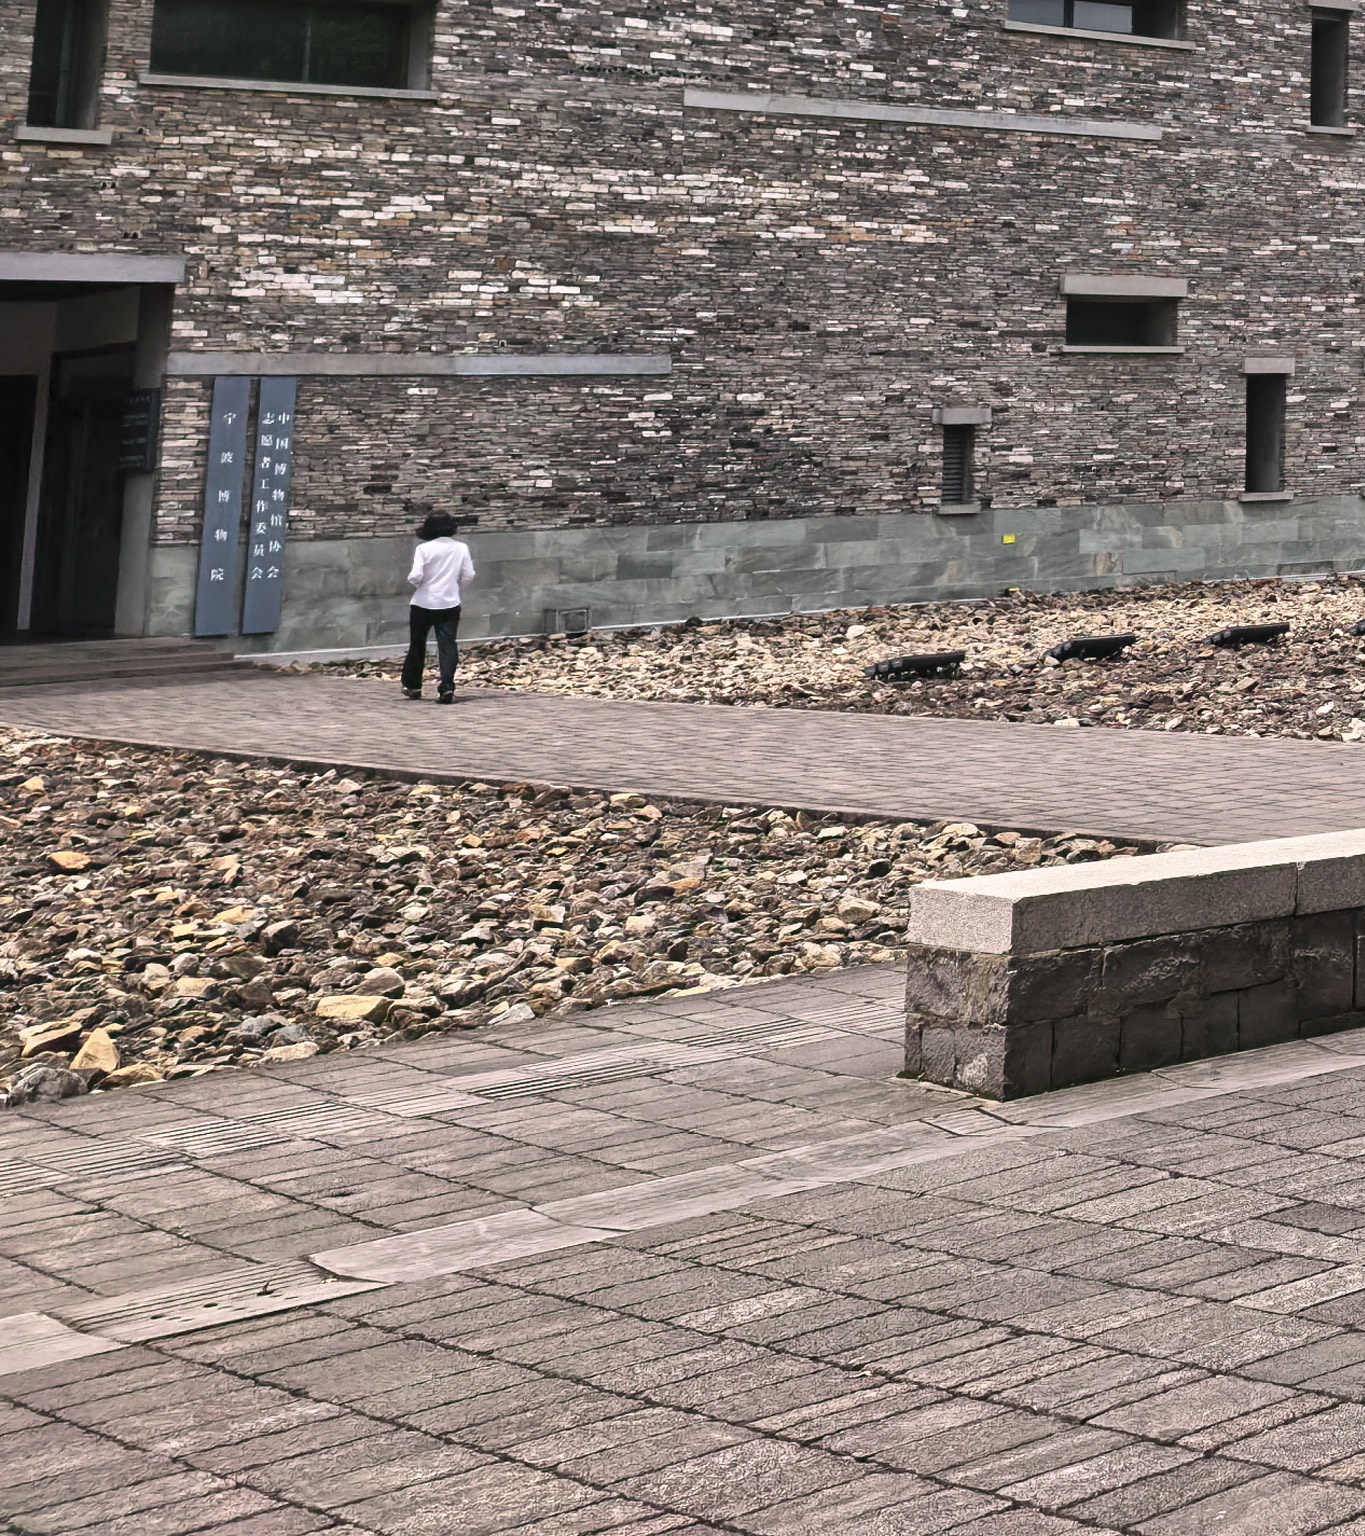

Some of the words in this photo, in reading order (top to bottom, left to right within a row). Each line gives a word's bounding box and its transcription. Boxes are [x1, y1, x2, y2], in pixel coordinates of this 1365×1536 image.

[210, 412, 237, 582] 宁波博物院
[251, 412, 275, 580] 志愿者工作委员会
[267, 412, 291, 579] 中国博物馆协会
